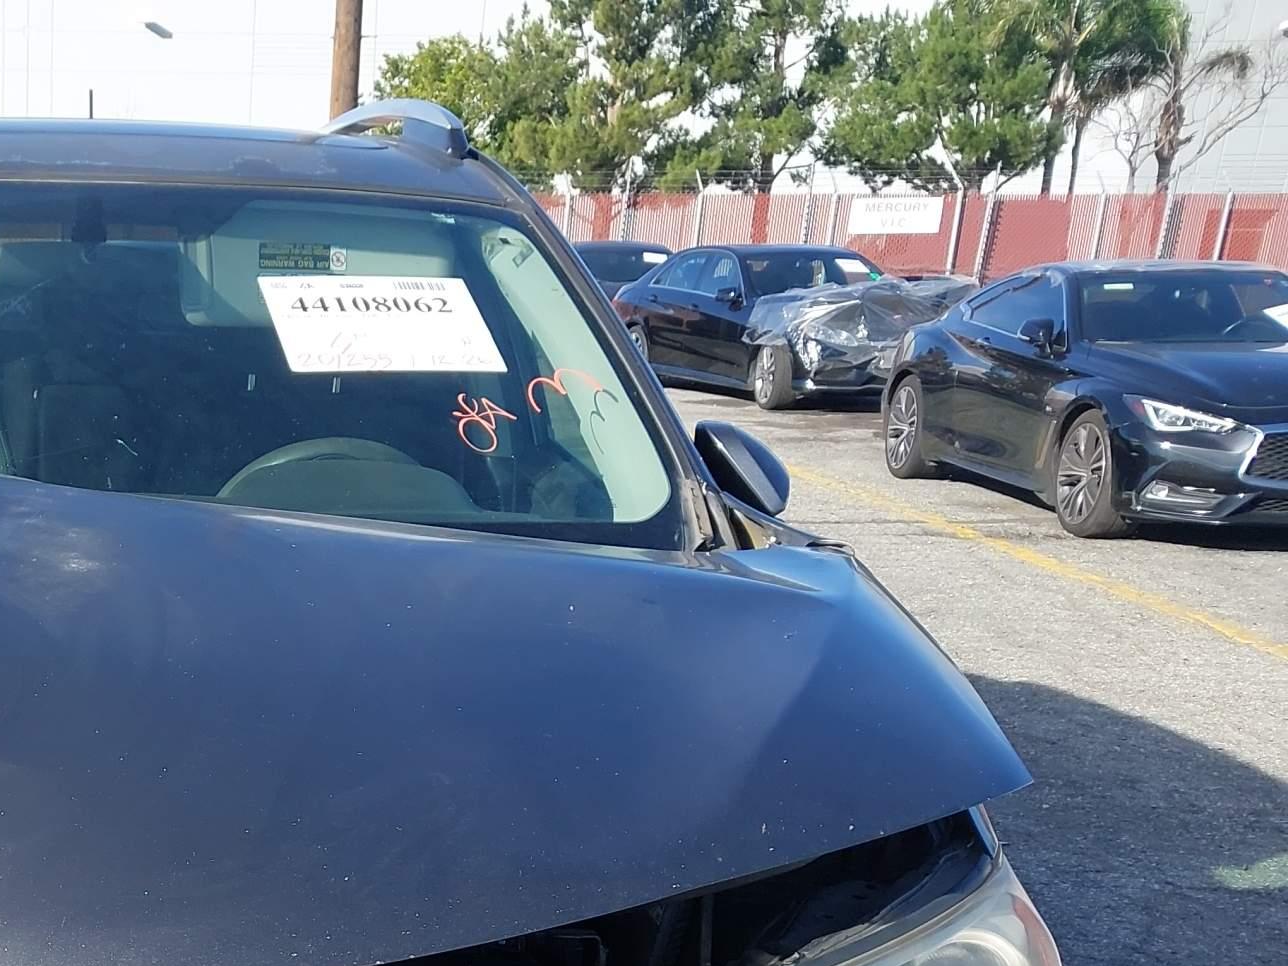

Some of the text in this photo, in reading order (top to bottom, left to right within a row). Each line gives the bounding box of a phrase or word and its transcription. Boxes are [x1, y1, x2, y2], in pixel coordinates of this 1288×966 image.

[865, 202, 929, 213] MERCURY
[261, 258, 295, 268] WARNING
[290, 296, 453, 313] 44108062
